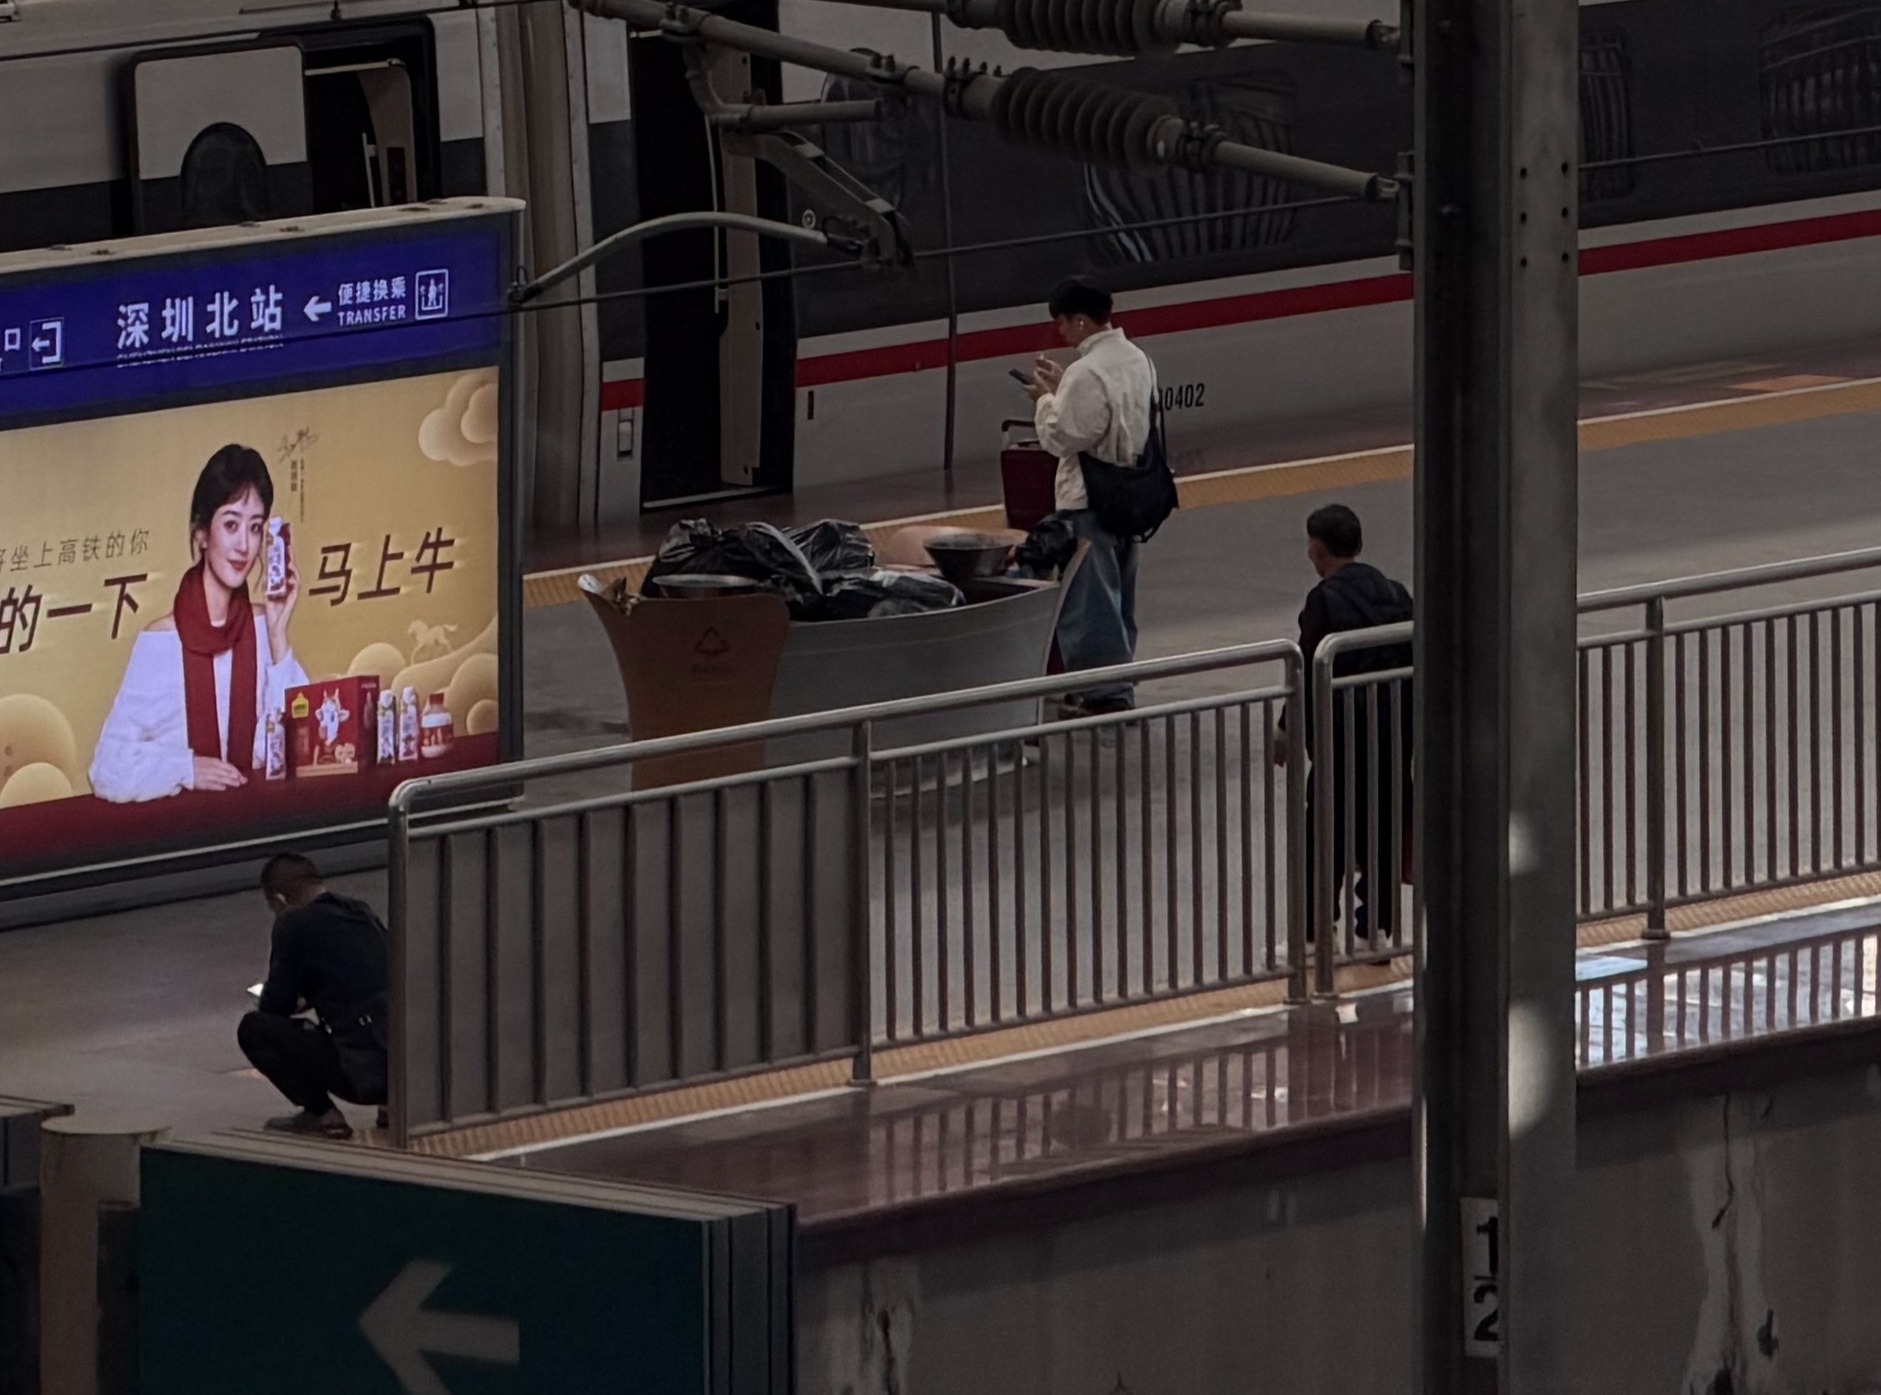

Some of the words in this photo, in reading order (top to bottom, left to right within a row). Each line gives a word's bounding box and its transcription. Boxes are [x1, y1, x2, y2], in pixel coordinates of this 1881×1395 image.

[338, 276, 406, 306] 便捷换乘
[117, 284, 283, 349] 深圳北站
[338, 304, 406, 326] TRANSFER
[308, 526, 456, 607] 马上牛
